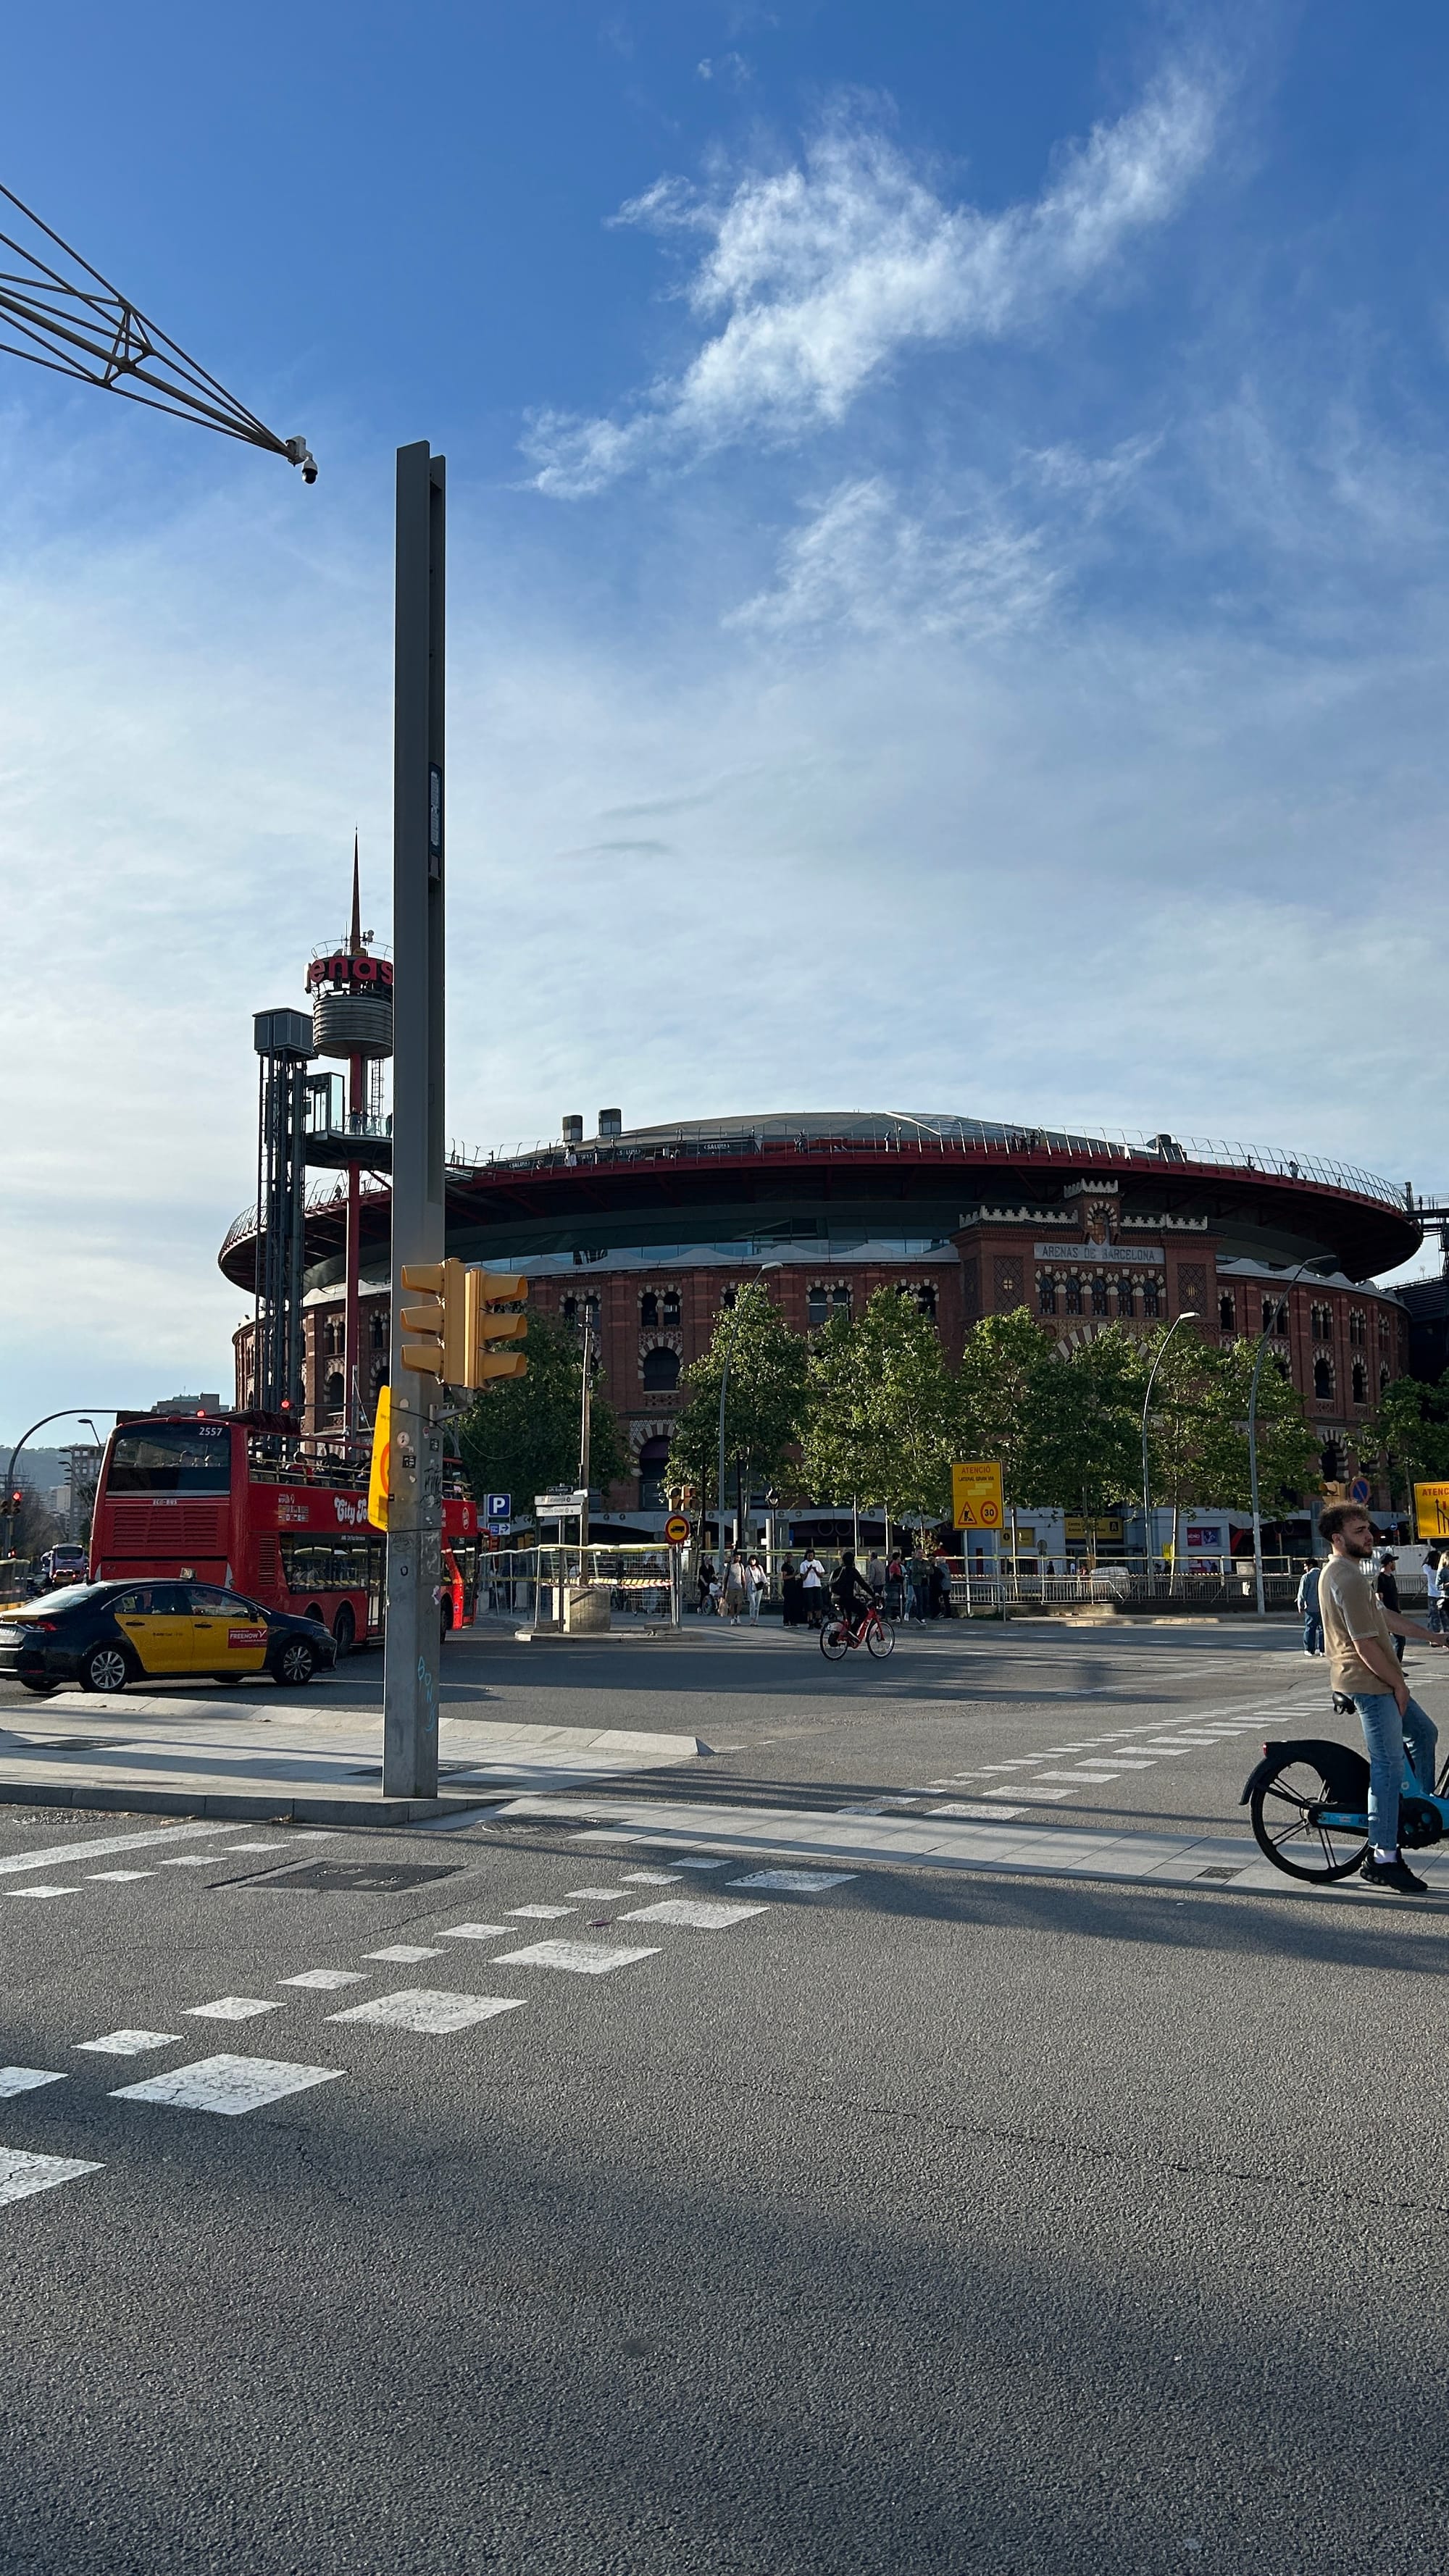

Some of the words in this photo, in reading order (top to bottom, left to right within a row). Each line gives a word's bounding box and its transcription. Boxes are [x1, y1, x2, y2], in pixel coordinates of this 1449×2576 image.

[1043, 1246, 1078, 1258] ARENAS
[1103, 1248, 1155, 1261] BARCELONA
[199, 1427, 222, 1436] 2557
[334, 1497, 356, 1526] City
[356, 1498, 368, 1523] To
[493, 1497, 506, 1514] P
